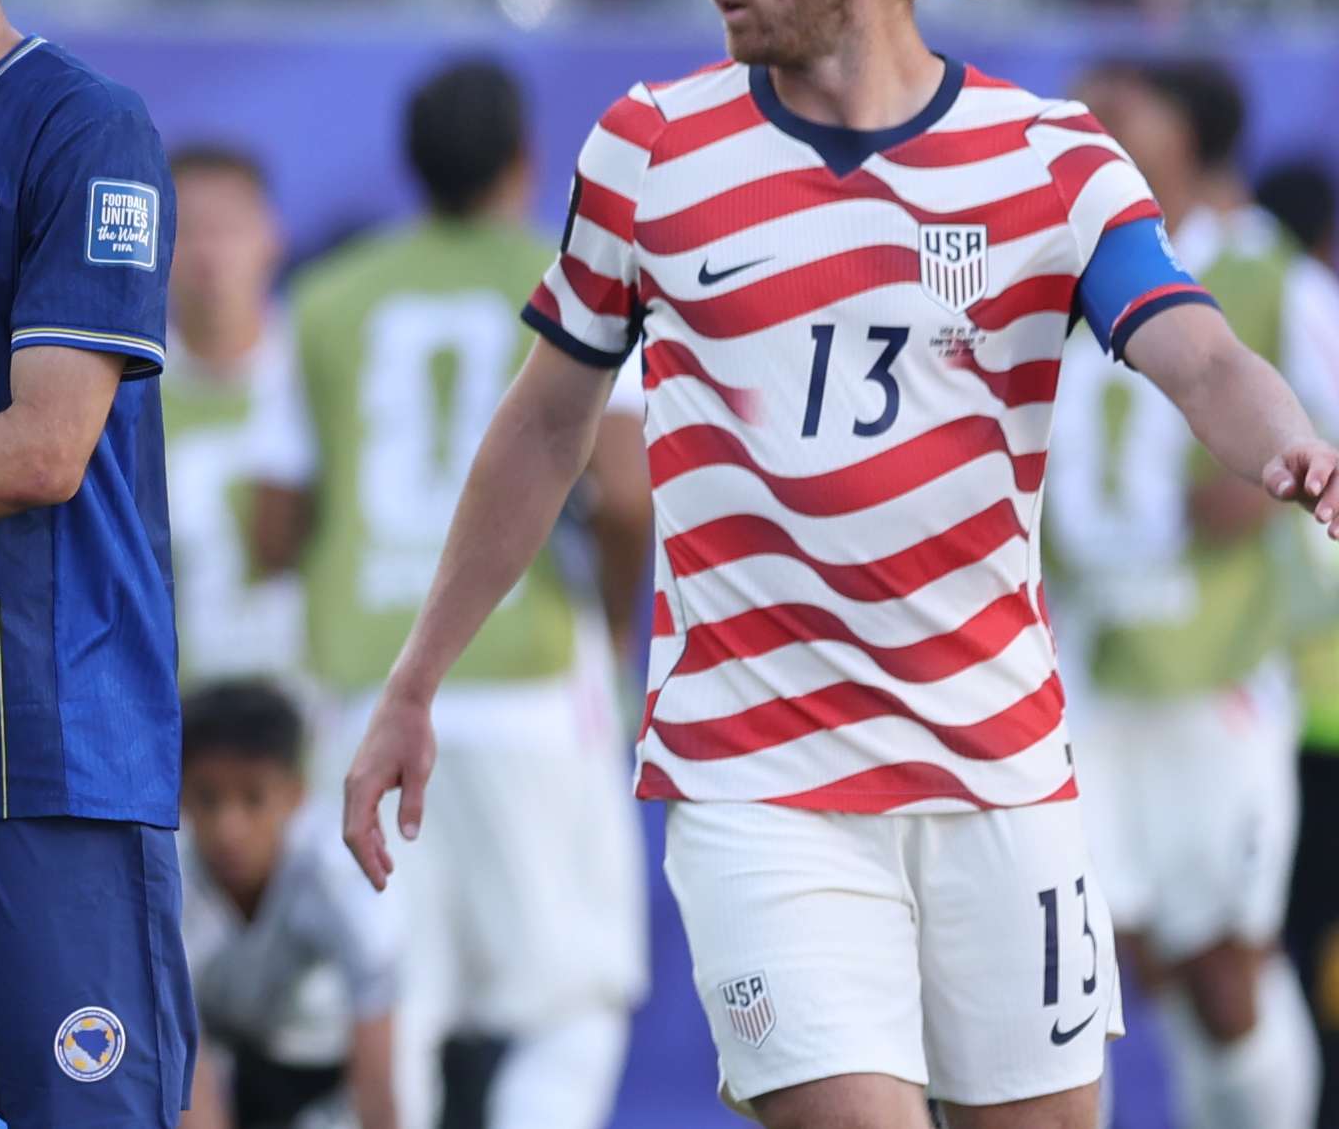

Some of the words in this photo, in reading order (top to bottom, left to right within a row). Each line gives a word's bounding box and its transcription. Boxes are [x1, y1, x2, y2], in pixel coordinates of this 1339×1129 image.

[103, 192, 148, 212] FOOTBALL
[101, 207, 149, 230] UNITES
[97, 225, 117, 242] the
[117, 225, 151, 247] World
[112, 243, 134, 253] FIFA
[925, 231, 982, 263] USA
[801, 324, 910, 428] 13
[1038, 874, 1097, 1007] 13
[723, 976, 763, 1008] USA
